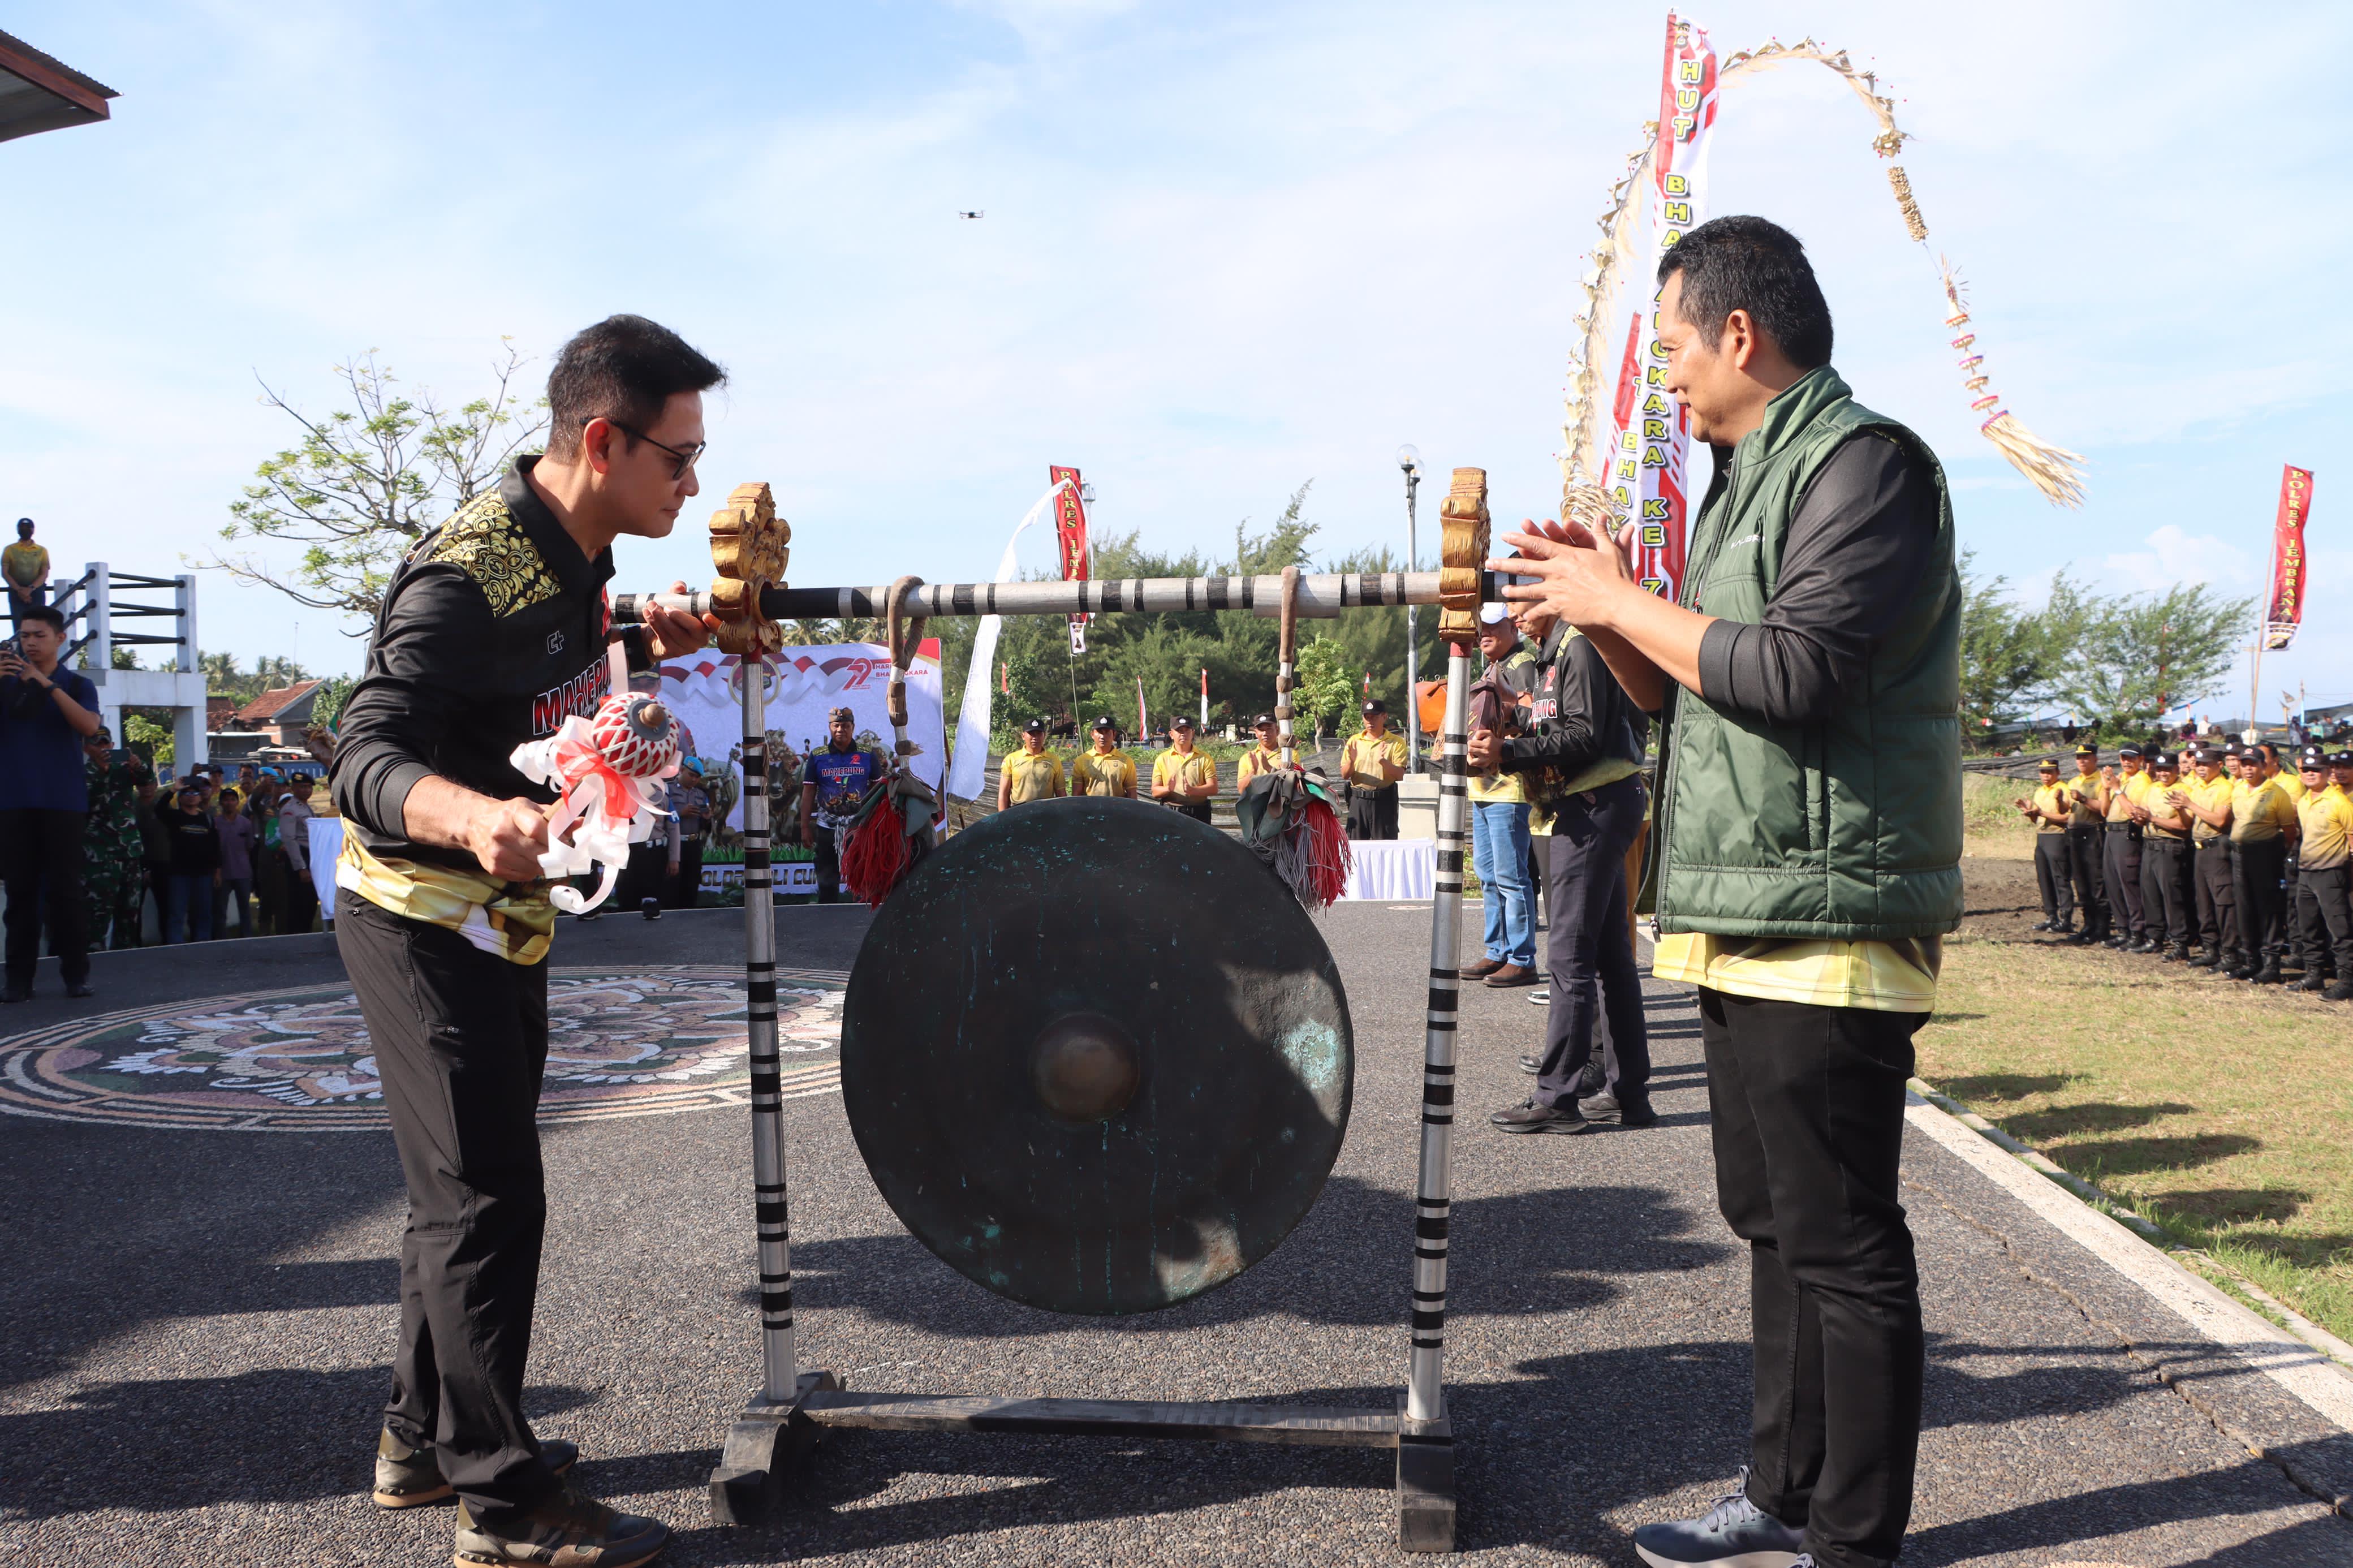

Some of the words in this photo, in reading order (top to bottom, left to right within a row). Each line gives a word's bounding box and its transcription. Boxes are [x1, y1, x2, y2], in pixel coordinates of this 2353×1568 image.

[1674, 61, 1701, 138] HUT
[1643, 175, 1688, 463] BHAGKARA
[1643, 499, 1664, 544] KE
[2288, 470, 2305, 528] POLRES
[2280, 539, 2300, 617] JEMBRANA
